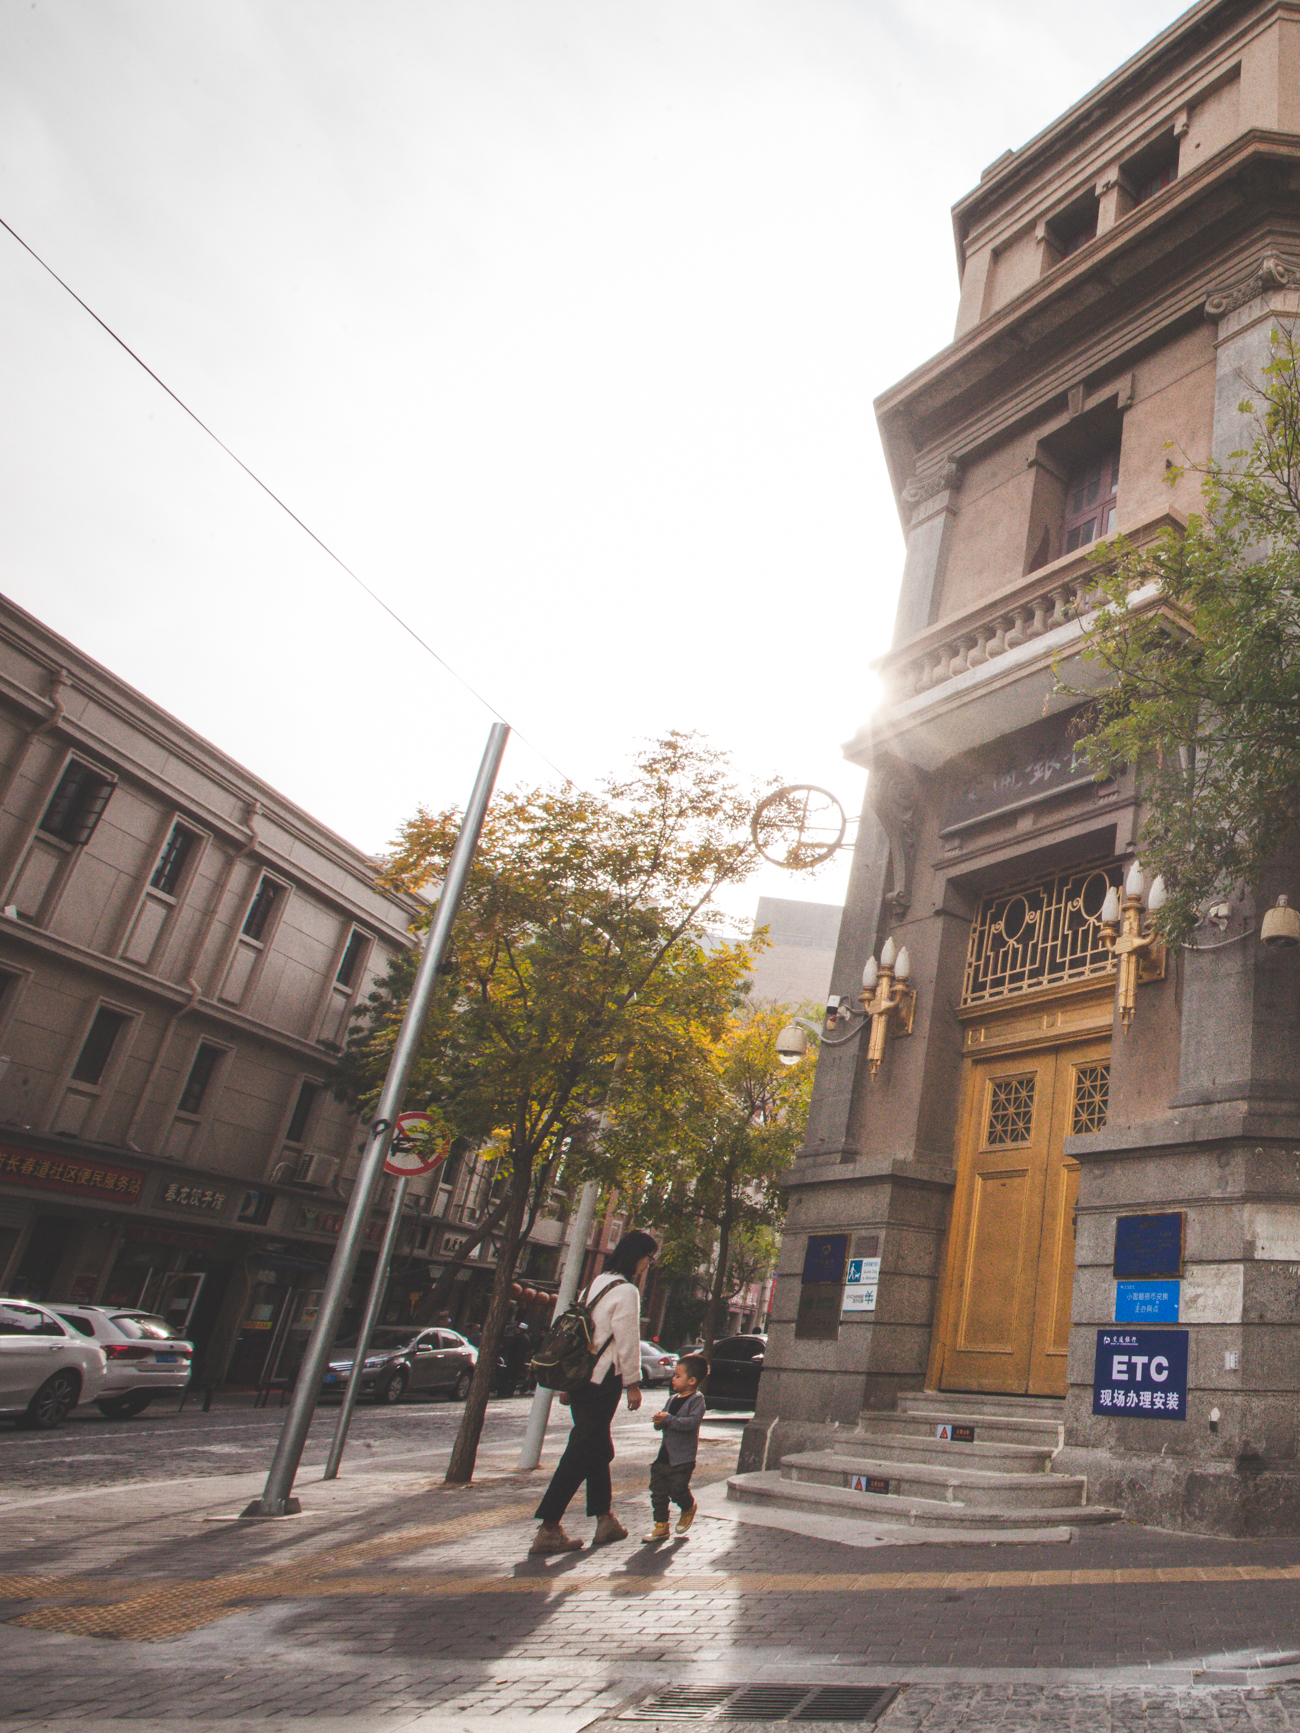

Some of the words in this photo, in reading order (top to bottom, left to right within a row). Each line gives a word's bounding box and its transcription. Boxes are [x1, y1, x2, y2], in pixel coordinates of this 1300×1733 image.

[1111, 1354, 1169, 1383] ETC
[1100, 1389, 1180, 1411] 现场办理安装
